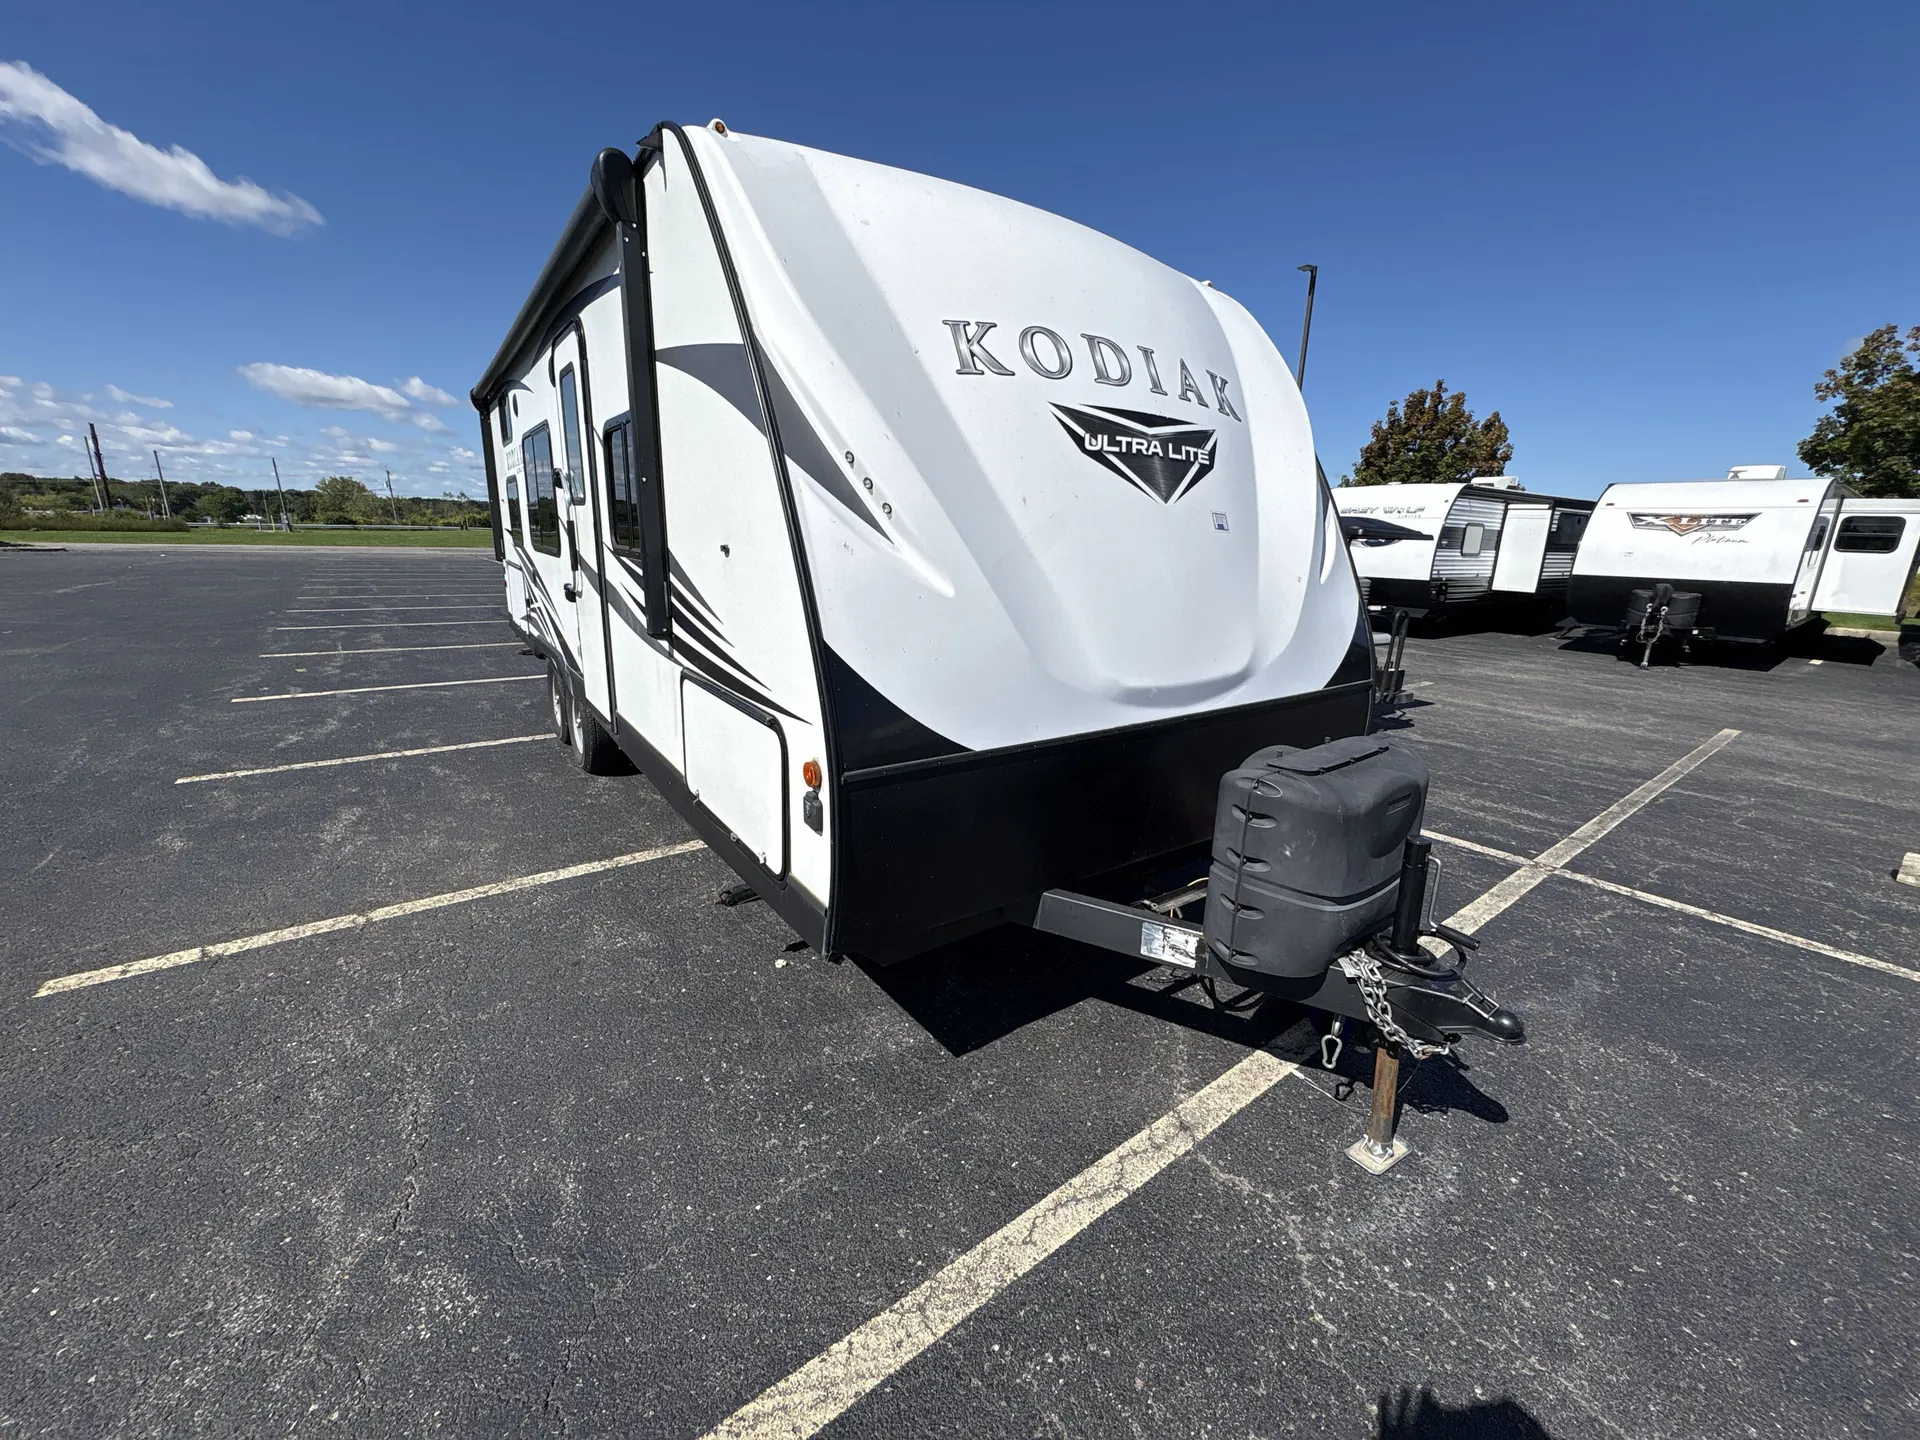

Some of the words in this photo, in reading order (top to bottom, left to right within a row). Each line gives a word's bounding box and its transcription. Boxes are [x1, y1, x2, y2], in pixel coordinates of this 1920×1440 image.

[942, 319, 1242, 422] KODIAK
[1084, 433, 1164, 457] ULTRA
[1168, 442, 1210, 466] LITE
[1691, 532, 1751, 545] Platinum
